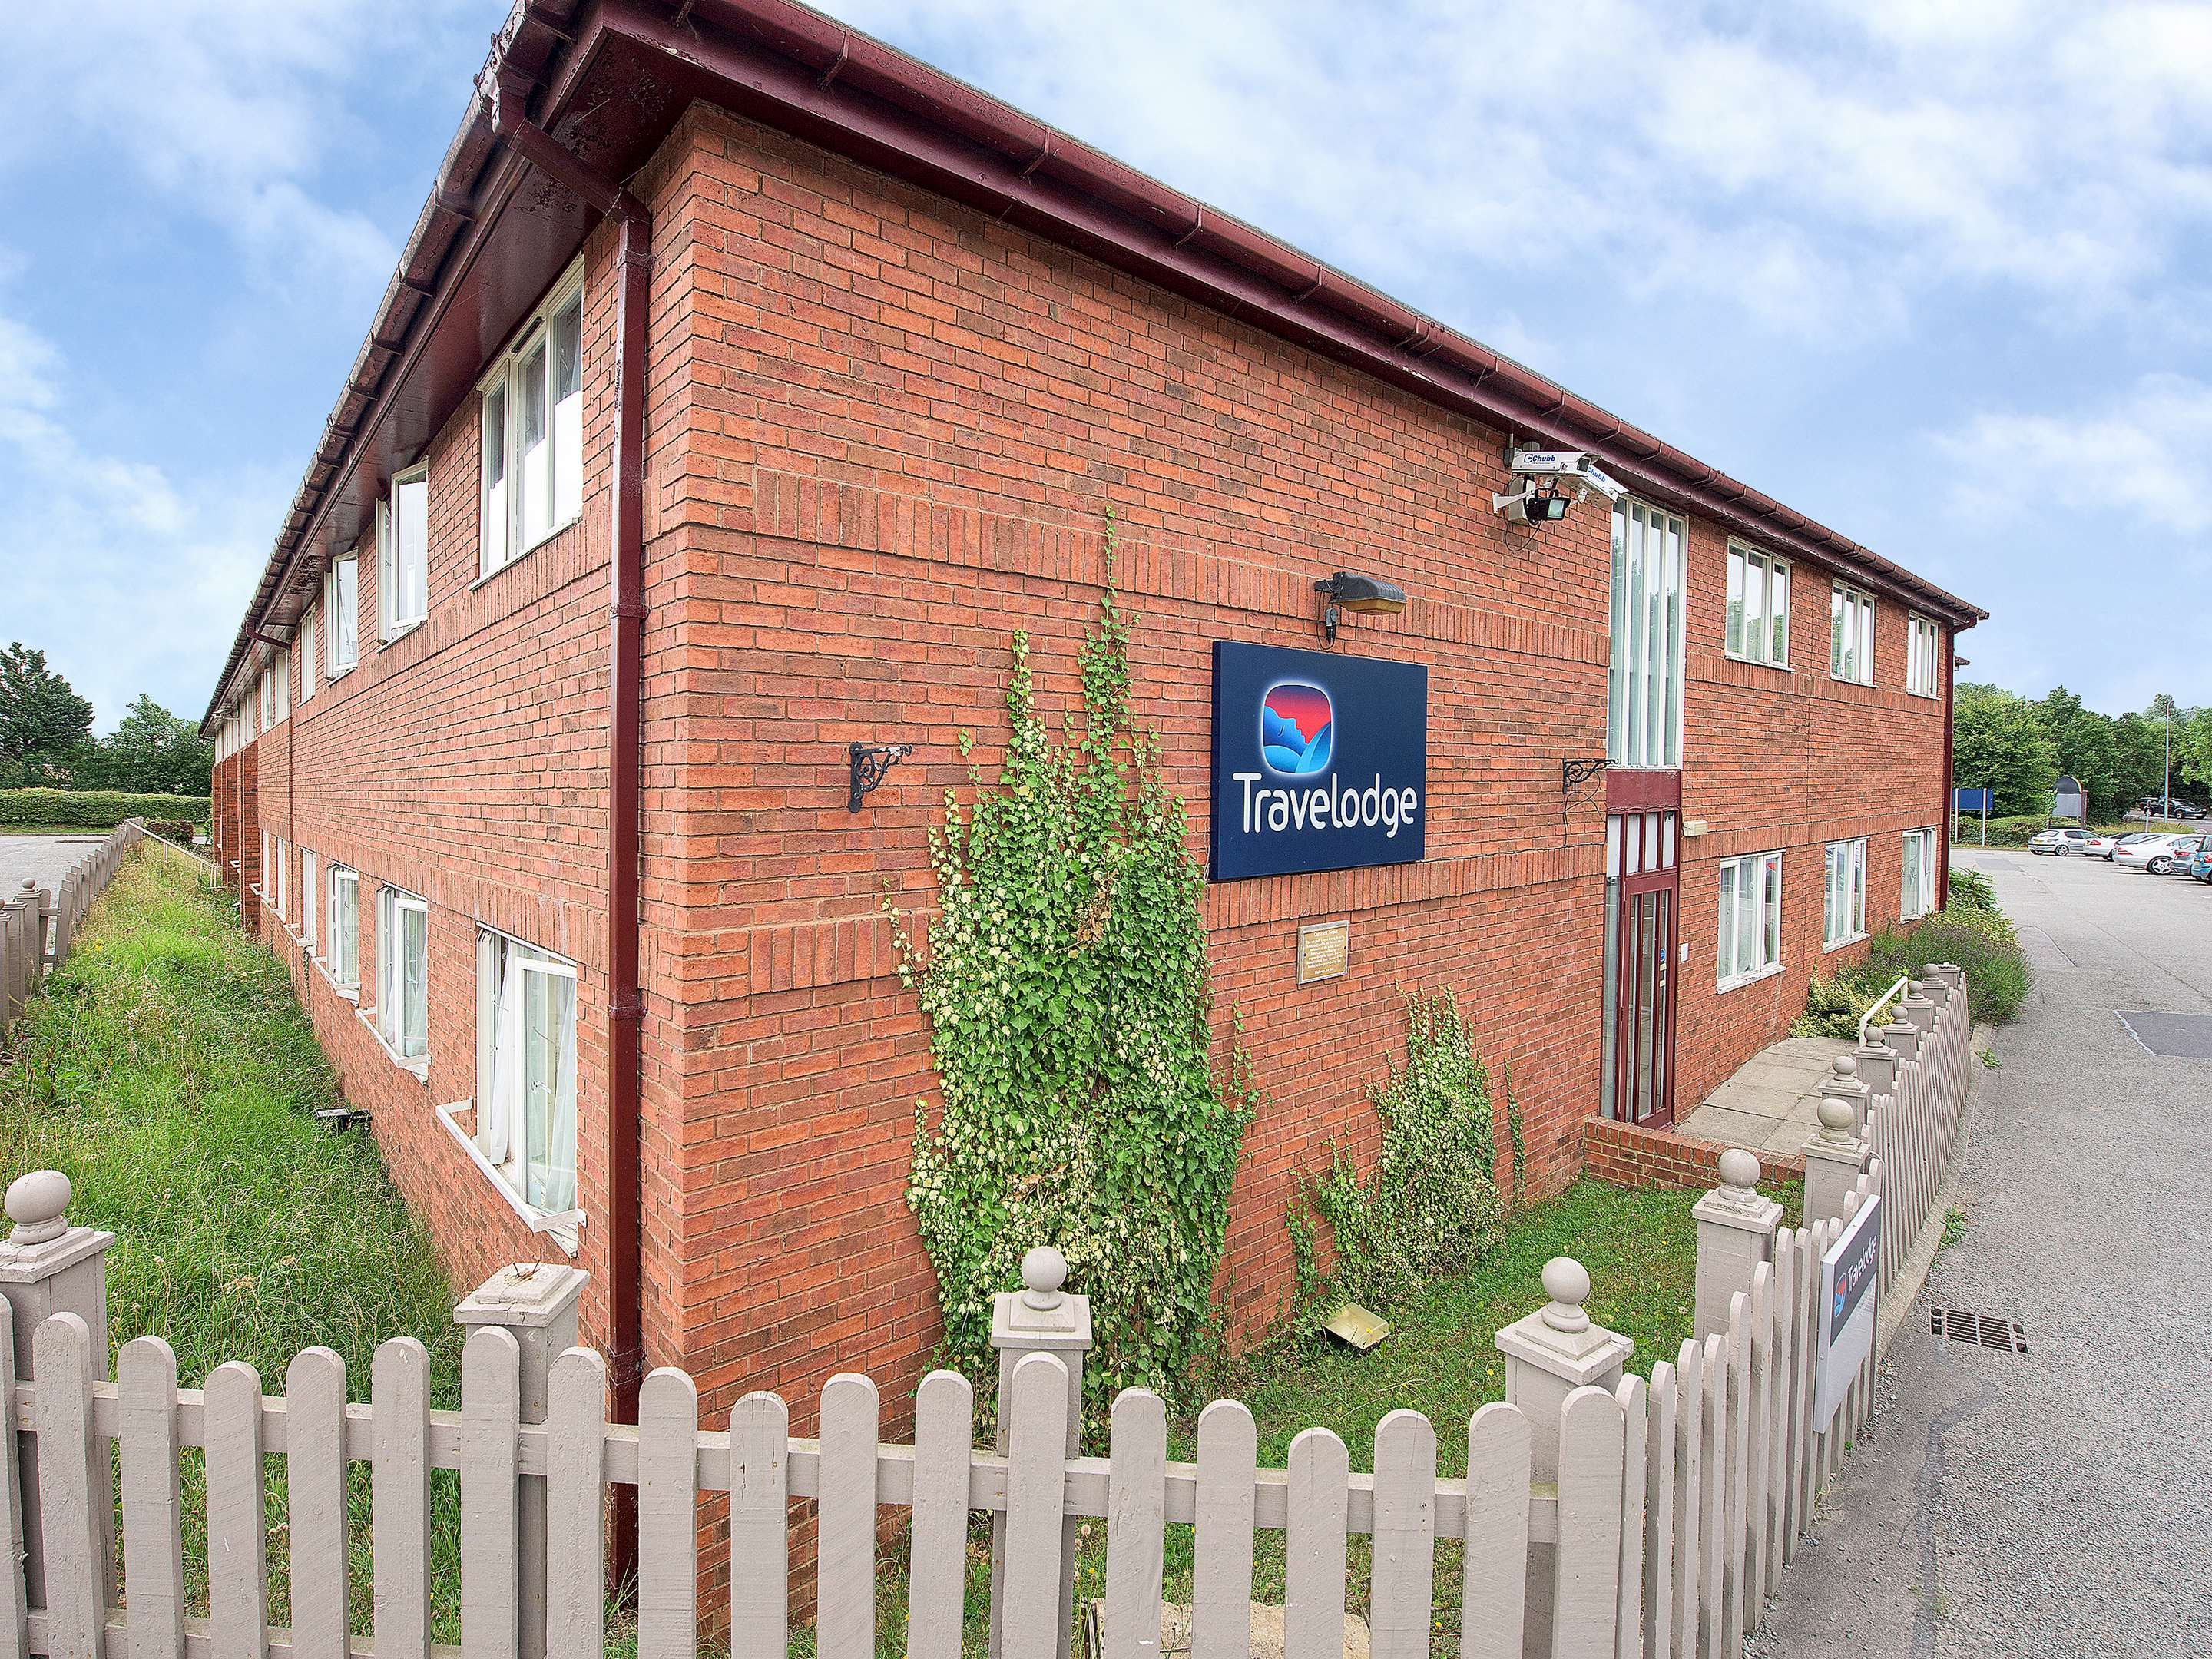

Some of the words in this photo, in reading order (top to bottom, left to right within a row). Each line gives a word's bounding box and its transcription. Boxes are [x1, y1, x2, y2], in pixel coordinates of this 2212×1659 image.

[1532, 453, 1555, 462] Chubb
[1232, 772, 1418, 838] Travelodge
[1848, 1235, 1877, 1294] Travelodge
